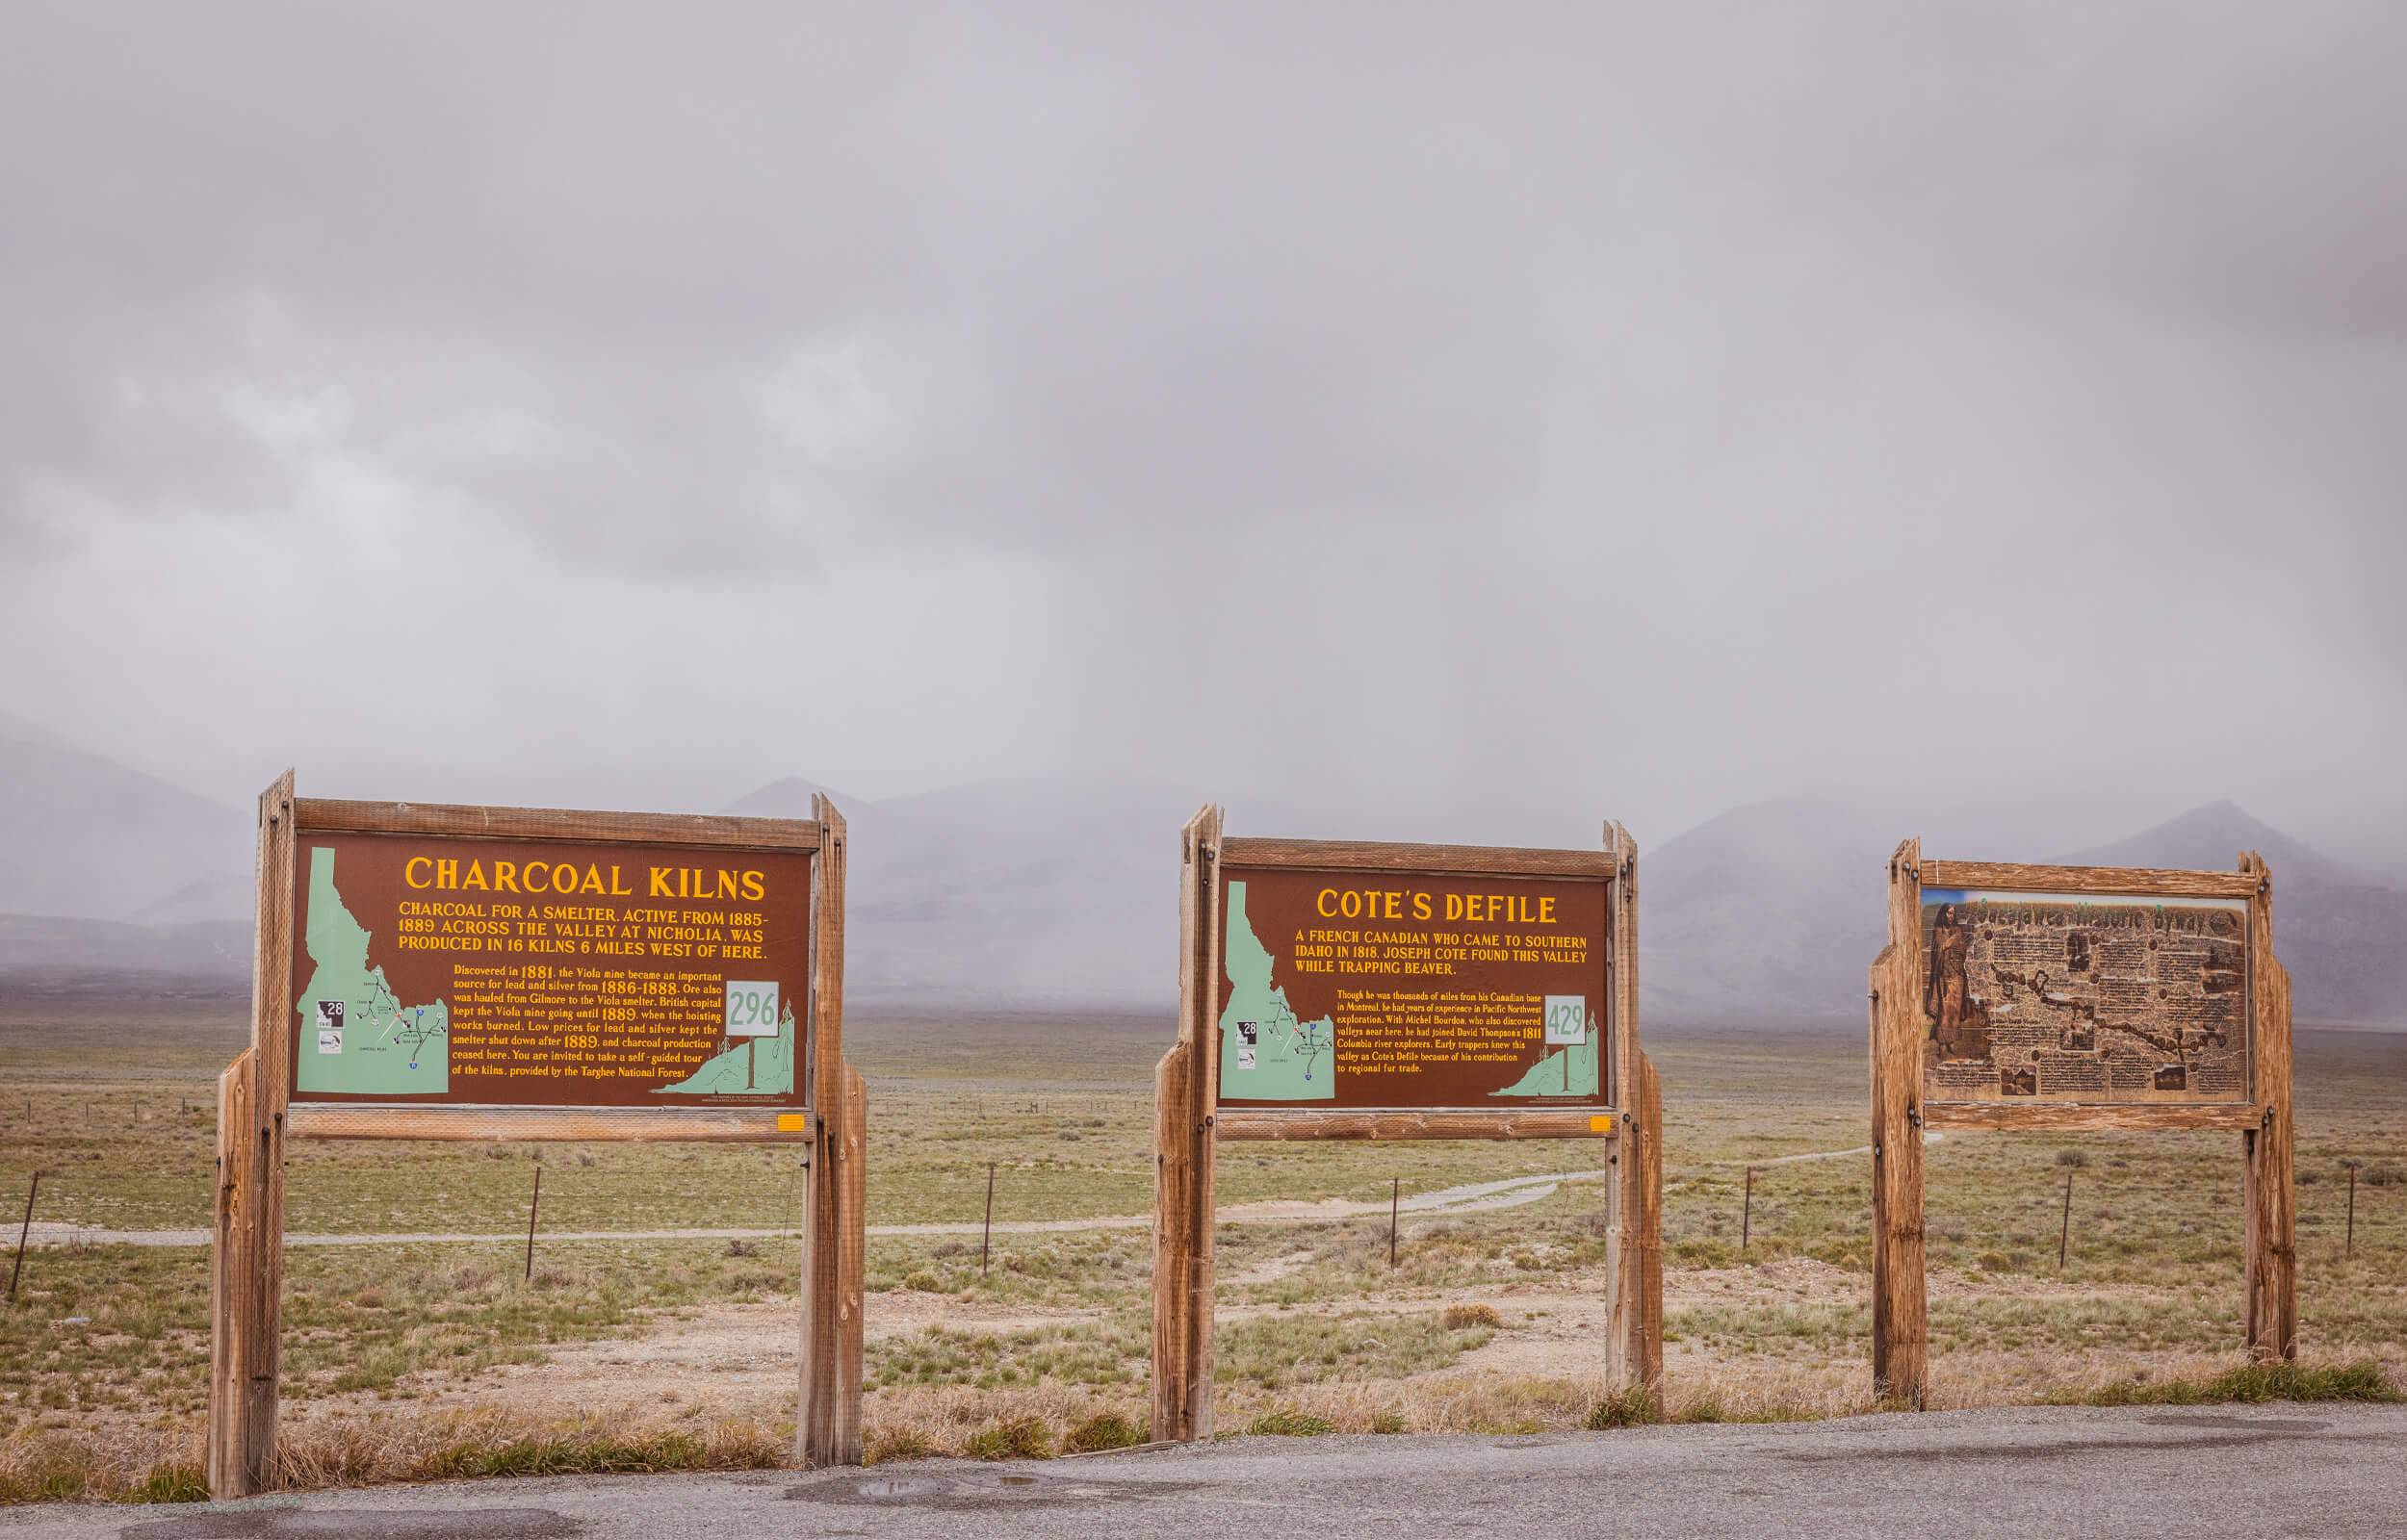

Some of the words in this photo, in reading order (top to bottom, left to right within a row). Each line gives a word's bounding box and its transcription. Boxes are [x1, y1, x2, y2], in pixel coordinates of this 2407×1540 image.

[405, 857, 632, 894] CHARCOAL
[649, 867, 764, 901] KILNS
[399, 901, 486, 916] CHARCOAL
[491, 905, 522, 918] FOR
[527, 906, 538, 918] A
[623, 909, 677, 922] ACTIVE
[683, 911, 724, 924] FROM
[730, 912, 768, 926] 1885-
[1317, 888, 1431, 919] COTE'S
[1446, 894, 1556, 922] DEFILE
[399, 918, 434, 932] 1889
[441, 919, 508, 935] ACROSS
[516, 922, 547, 935] THE
[555, 923, 615, 937] VALLEY
[620, 925, 640, 937] AT
[731, 929, 763, 942] WAS
[1295, 929, 1304, 940] A
[1309, 930, 1359, 942] FRENCH
[1364, 931, 1427, 943] CANADIAN
[1433, 933, 1459, 944] WHO
[1463, 934, 1499, 945] CAME
[1504, 935, 1520, 946] TO
[1525, 936, 1586, 948] SOUTHERN
[399, 936, 481, 950] PRODUCED
[487, 937, 502, 951] IN
[508, 938, 523, 951] 16
[529, 939, 575, 953] KILNS
[581, 940, 589, 953] 6
[595, 940, 644, 955] MILES
[650, 943, 691, 956] WEST
[697, 944, 716, 957] OF
[722, 945, 766, 959] HERE.
[1295, 944, 1333, 957] IDAHO
[1336, 945, 1348, 957] IN
[1383, 947, 1430, 959] JOSEPH
[1435, 947, 1466, 960] COTE
[1471, 949, 1508, 961] FOUND
[1512, 950, 1539, 962] THIS
[1543, 951, 1587, 962] VALLEY
[454, 964, 505, 975] Discovered
[508, 966, 518, 975] in
[558, 966, 573, 977] the
[577, 967, 600, 978] Viola
[628, 969, 662, 979] became
[678, 971, 720, 983] important
[1295, 960, 1333, 972] WHILE
[1338, 961, 1400, 973] TRAPPING
[1405, 962, 1456, 974] BEAVER.
[488, 979, 502, 988] for
[505, 978, 525, 988] lead
[528, 979, 545, 989] and
[548, 980, 575, 989] silver
[578, 981, 598, 990] from
[602, 981, 680, 994] 1886-1888.
[683, 984, 700, 993] Ore
[703, 984, 721, 993] also
[327, 1003, 343, 1015] 28
[474, 991, 504, 1002] hauled
[506, 993, 527, 1003] from
[530, 992, 565, 1004] Gilmore
[581, 994, 593, 1004] the
[597, 994, 620, 1005] Viola
[622, 994, 657, 1006] smelter.
[660, 996, 688, 1006] British
[691, 997, 720, 1009] capital
[729, 991, 775, 1026] 296
[453, 1005, 474, 1017] kept
[478, 1006, 492, 1015] the
[496, 1006, 520, 1016] Viola
[524, 1007, 545, 1016] mine
[548, 1008, 573, 1020] going
[576, 1008, 598, 1017] until
[641, 1009, 664, 1019] when
[668, 1010, 682, 1019] the
[686, 1010, 721, 1023] hoisting
[1385, 1014, 1402, 1023] With
[1406, 1014, 1431, 1024] Michel
[1468, 1015, 1483, 1024] who
[1486, 1015, 1500, 1024] also
[1502, 1016, 1540, 1025] discovered
[1547, 1004, 1583, 1035] 429
[453, 1020, 482, 1030] works
[486, 1020, 524, 1030] burned.
[529, 1020, 549, 1030] Low
[553, 1022, 582, 1034] prices
[586, 1022, 600, 1032] for
[605, 1021, 624, 1032] lead
[628, 1023, 645, 1033] and
[649, 1022, 676, 1033] silver
[680, 1024, 699, 1036] kept
[703, 1024, 717, 1034] the
[1244, 1022, 1256, 1035] 28
[453, 1034, 486, 1043] smelter
[488, 1034, 508, 1044] shut
[510, 1035, 535, 1044] down
[538, 1036, 561, 1045] after
[602, 1037, 618, 1046] and
[622, 1037, 660, 1047] charcoal
[663, 1038, 711, 1049] production
[1336, 1038, 1371, 1047] Columbia
[1435, 1039, 1456, 1050] Early
[1458, 1041, 1488, 1050] trappers
[1490, 1040, 1510, 1048] knew
[1512, 1040, 1525, 1048] this
[453, 1049, 483, 1059] ceased
[486, 1048, 510, 1059] here.
[512, 1049, 530, 1060] You
[551, 1050, 582, 1061] invited
[598, 1052, 616, 1061] take
[1336, 1051, 1359, 1062] valley
[1396, 1051, 1418, 1061] Defile
[1420, 1052, 1450, 1061] because
[1461, 1052, 1471, 1061] his
[452, 1065, 461, 1074] of
[464, 1064, 479, 1074] the
[509, 1065, 548, 1077] provided
[551, 1065, 562, 1077] by
[563, 1066, 578, 1076] the
[581, 1065, 615, 1079] Targhee
[618, 1066, 654, 1076] National
[658, 1067, 687, 1077] Forest.
